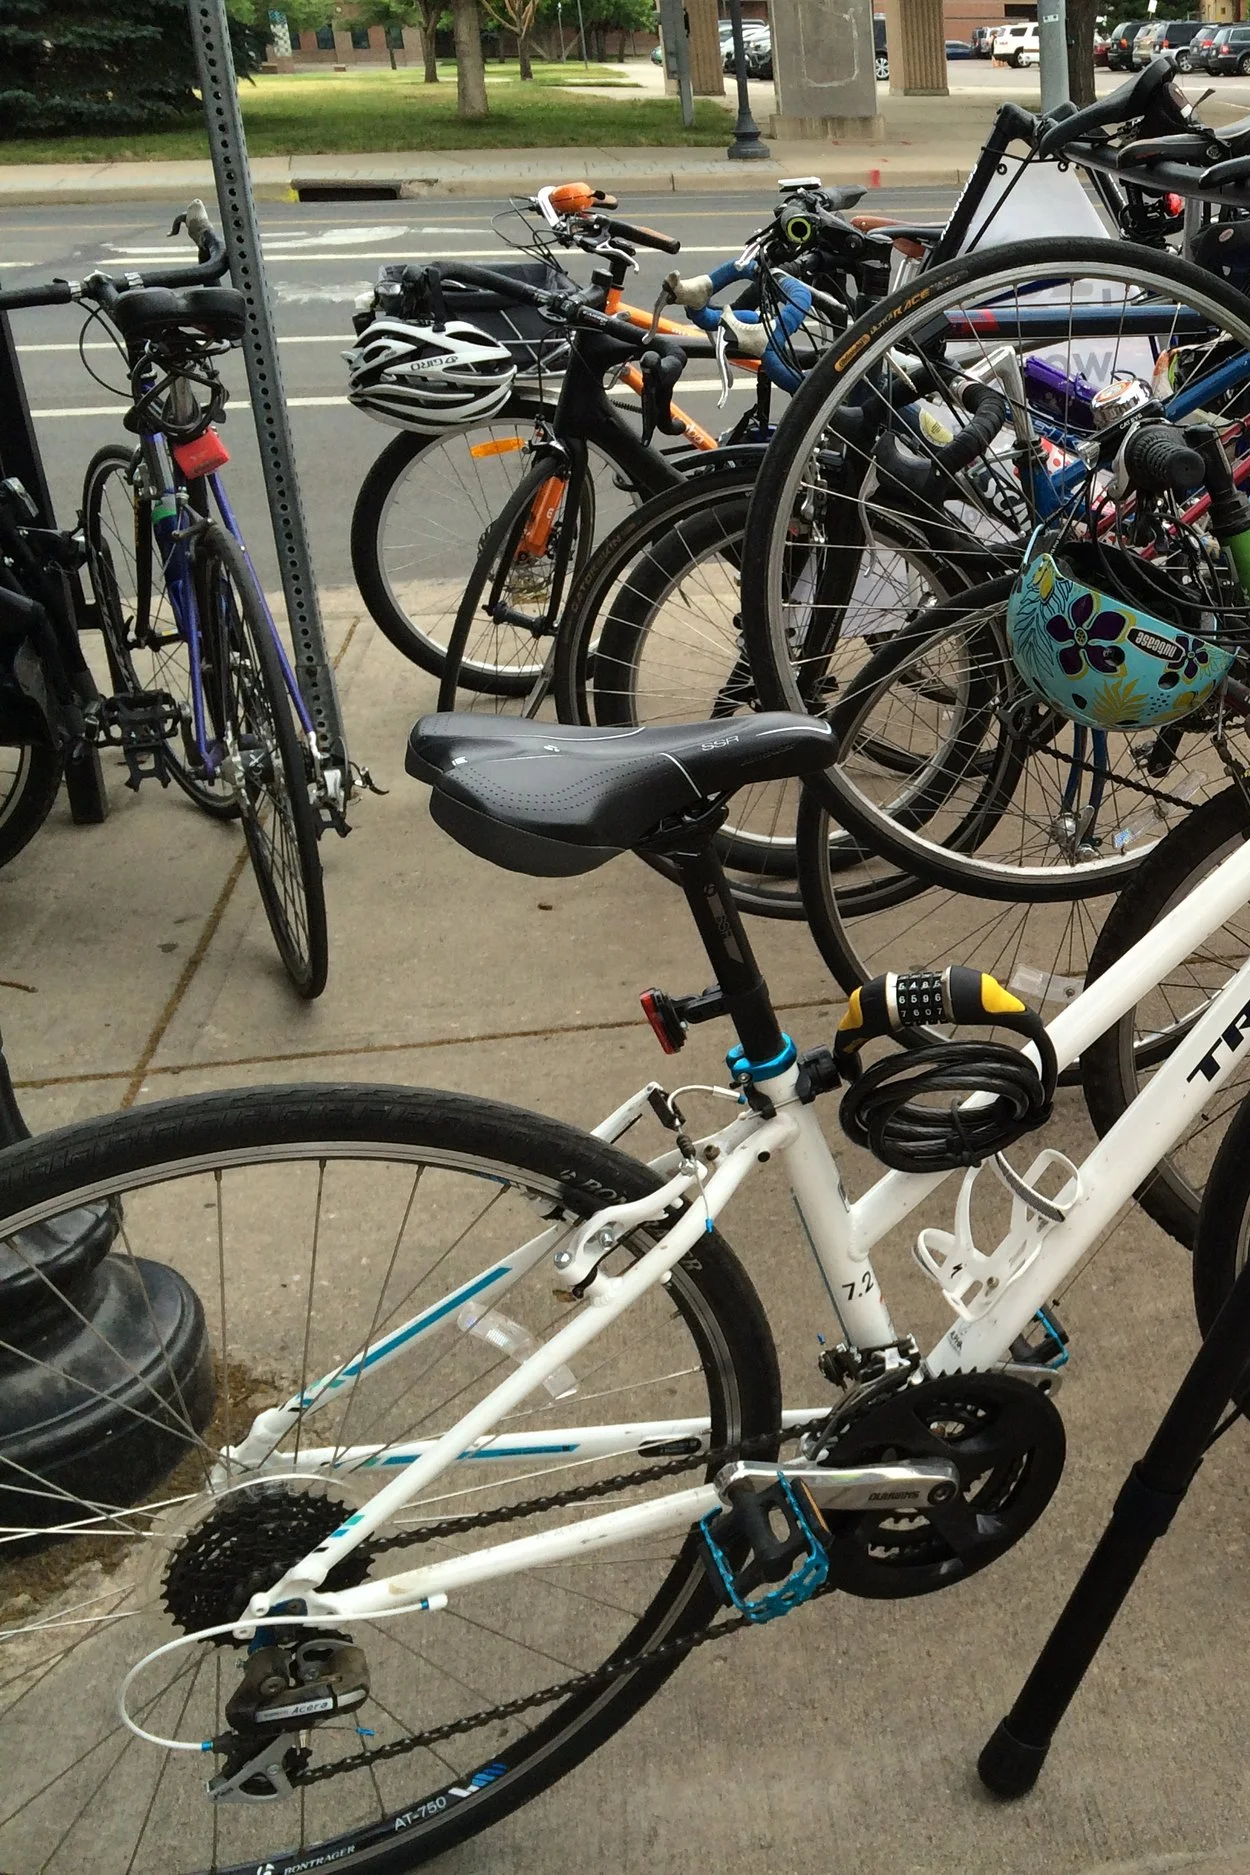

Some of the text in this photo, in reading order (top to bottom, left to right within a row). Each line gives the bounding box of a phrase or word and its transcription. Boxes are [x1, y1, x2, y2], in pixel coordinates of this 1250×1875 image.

[410, 356, 444, 371] GIRO
[1135, 631, 1177, 658] nutcase
[701, 735, 741, 752] SSR
[842, 1271, 875, 1301] 7.2
[291, 1701, 329, 1715] Acera
[394, 1796, 447, 1831] AT-750
[284, 1845, 355, 1875] BONTRAGER
